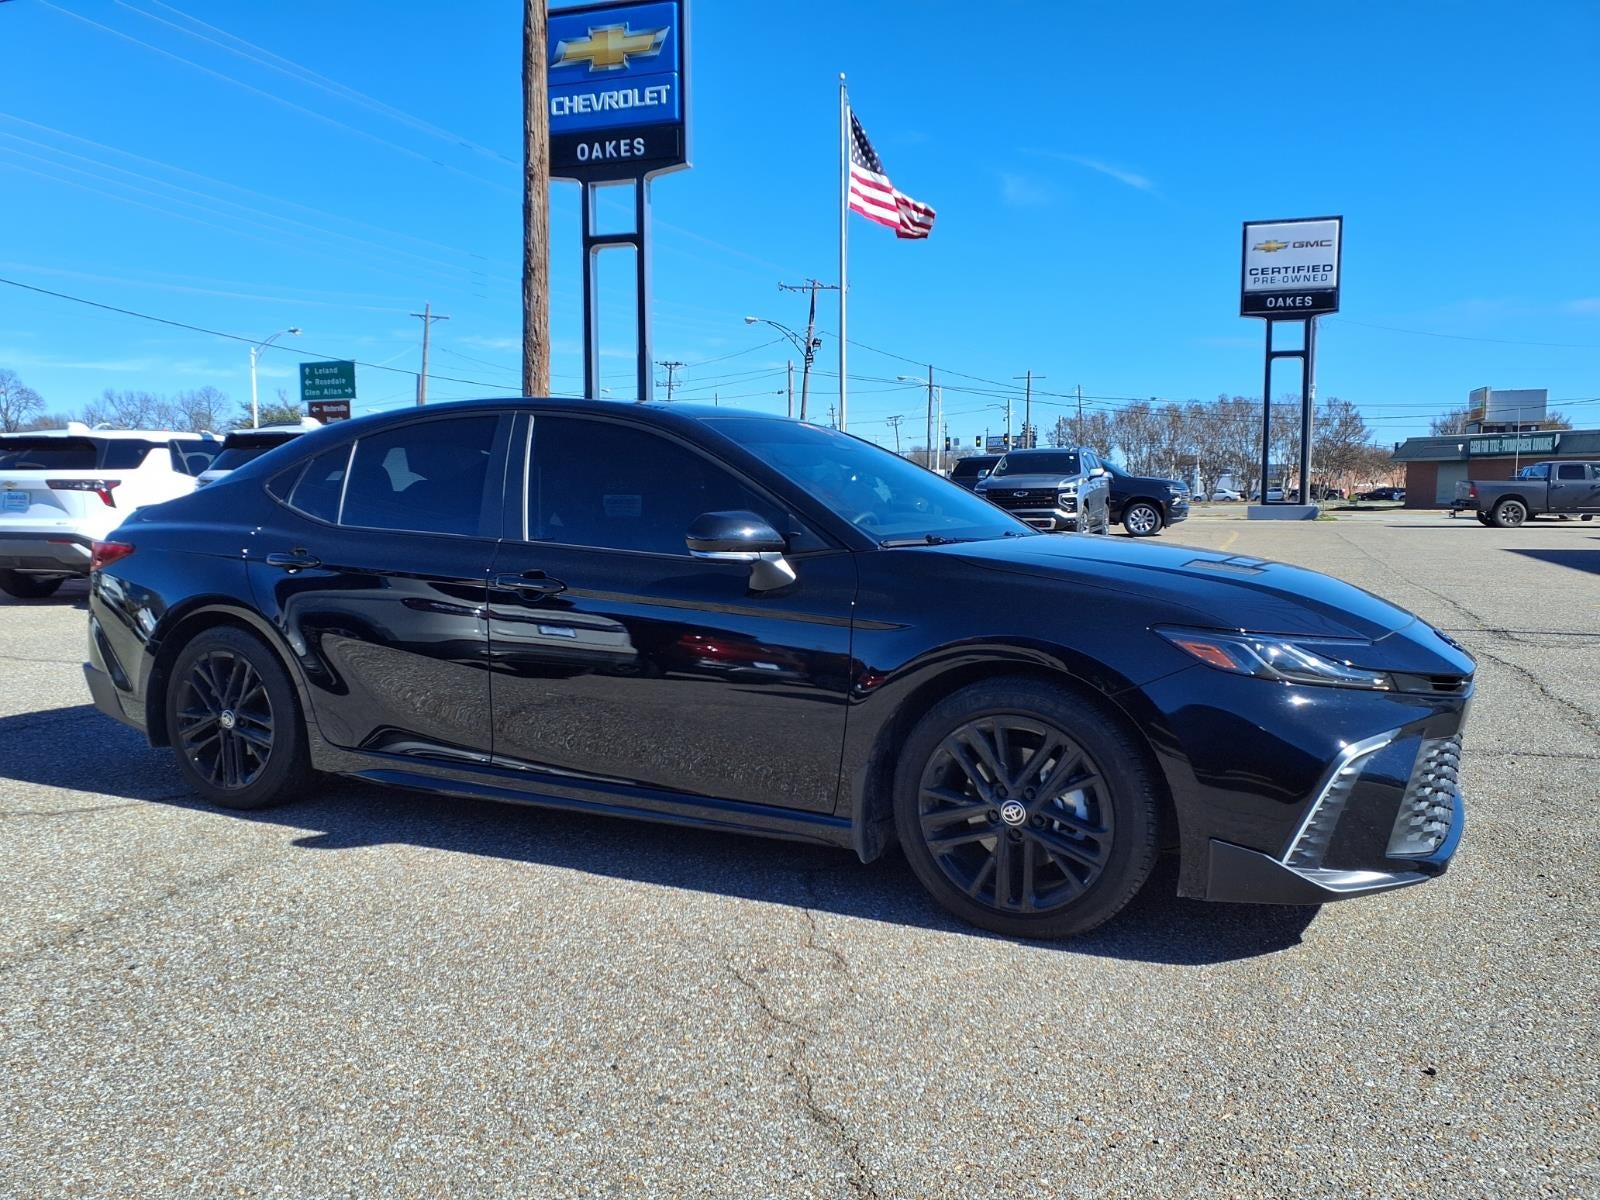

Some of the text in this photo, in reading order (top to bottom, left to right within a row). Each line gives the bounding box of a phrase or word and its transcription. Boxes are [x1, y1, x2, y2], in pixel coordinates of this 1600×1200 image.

[551, 84, 671, 116] CHEVROLET
[576, 137, 645, 161] OAKES
[1292, 240, 1333, 249] GMC
[1249, 264, 1334, 276] CERTIFIED
[1253, 274, 1328, 285] PRE-OWNED
[1266, 296, 1313, 308] OAKES
[314, 367, 338, 375] Leland
